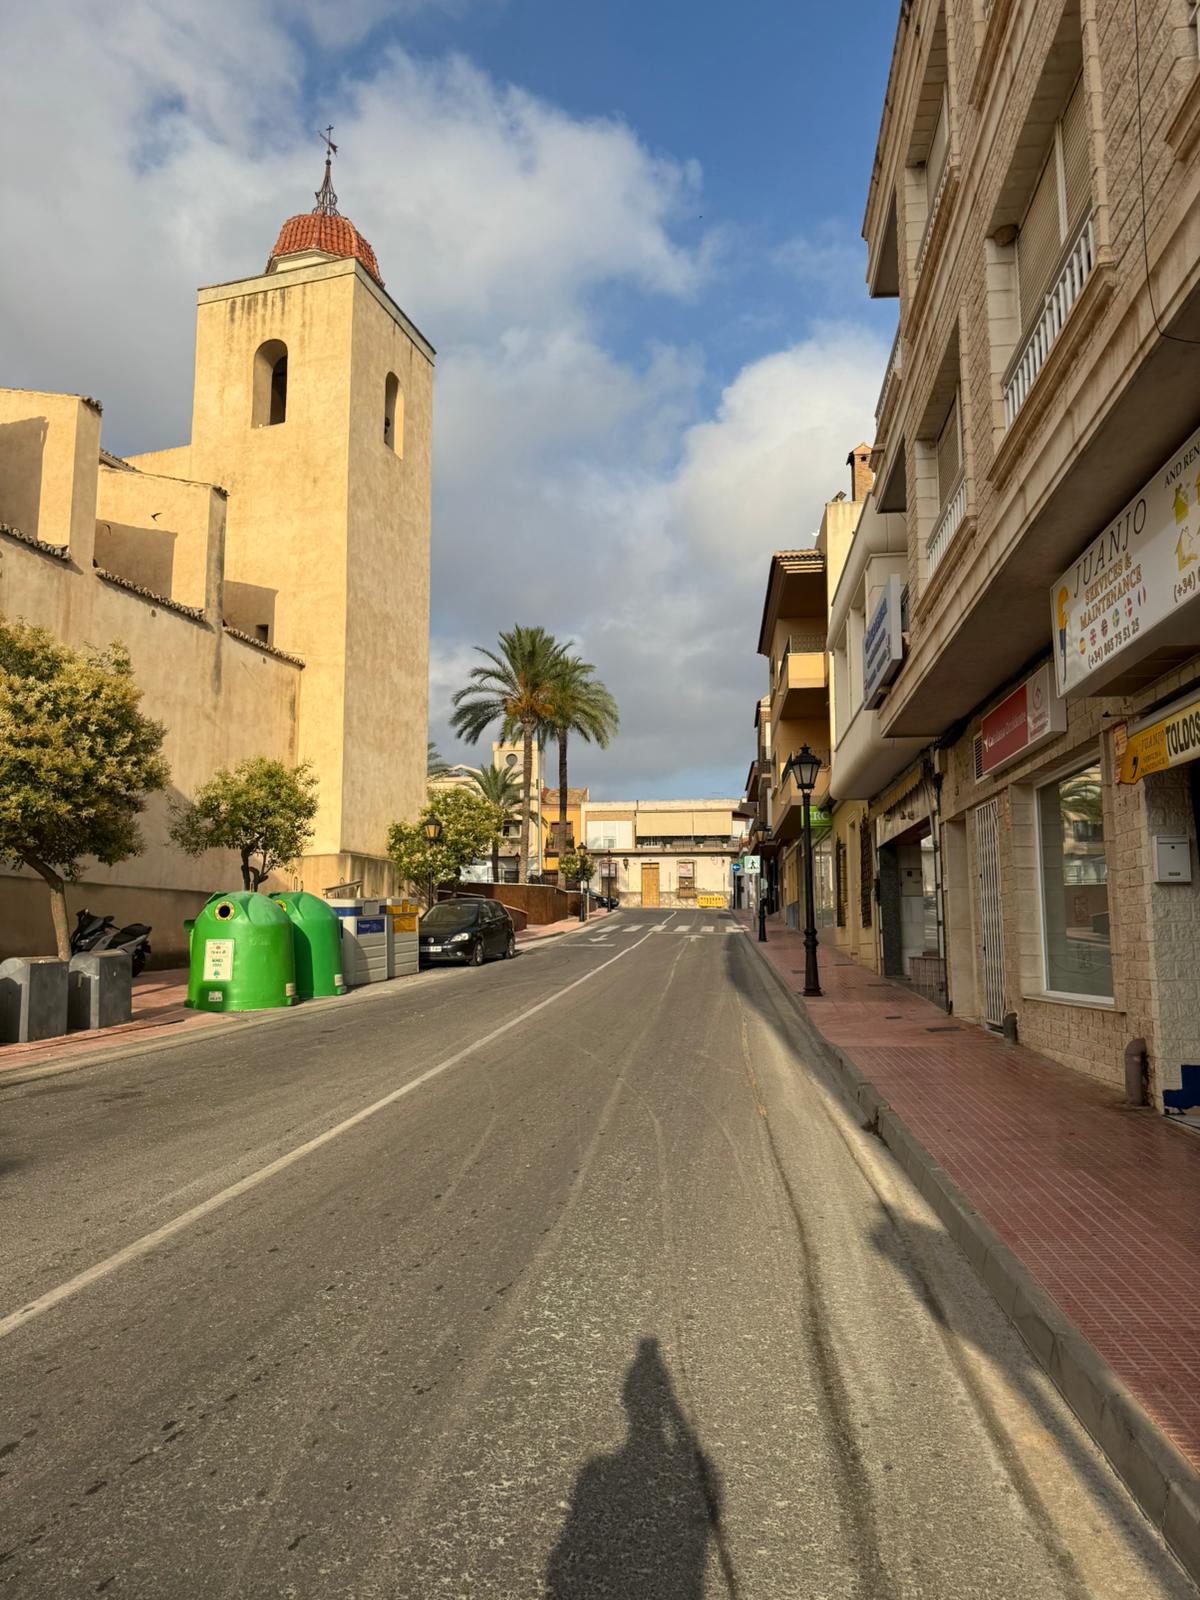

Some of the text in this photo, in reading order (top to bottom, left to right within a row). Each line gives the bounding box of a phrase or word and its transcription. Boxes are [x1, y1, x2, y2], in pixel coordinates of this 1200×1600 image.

[1165, 462, 1182, 488] AND
[1074, 498, 1147, 598] JUANJO
[1080, 563, 1142, 632] MAINTENANCE
[1084, 551, 1132, 606] SERVICES &
[1174, 571, 1196, 603] (+34)
[1088, 646, 1103, 669] (+34)
[1166, 711, 1200, 757] TOLDOS
